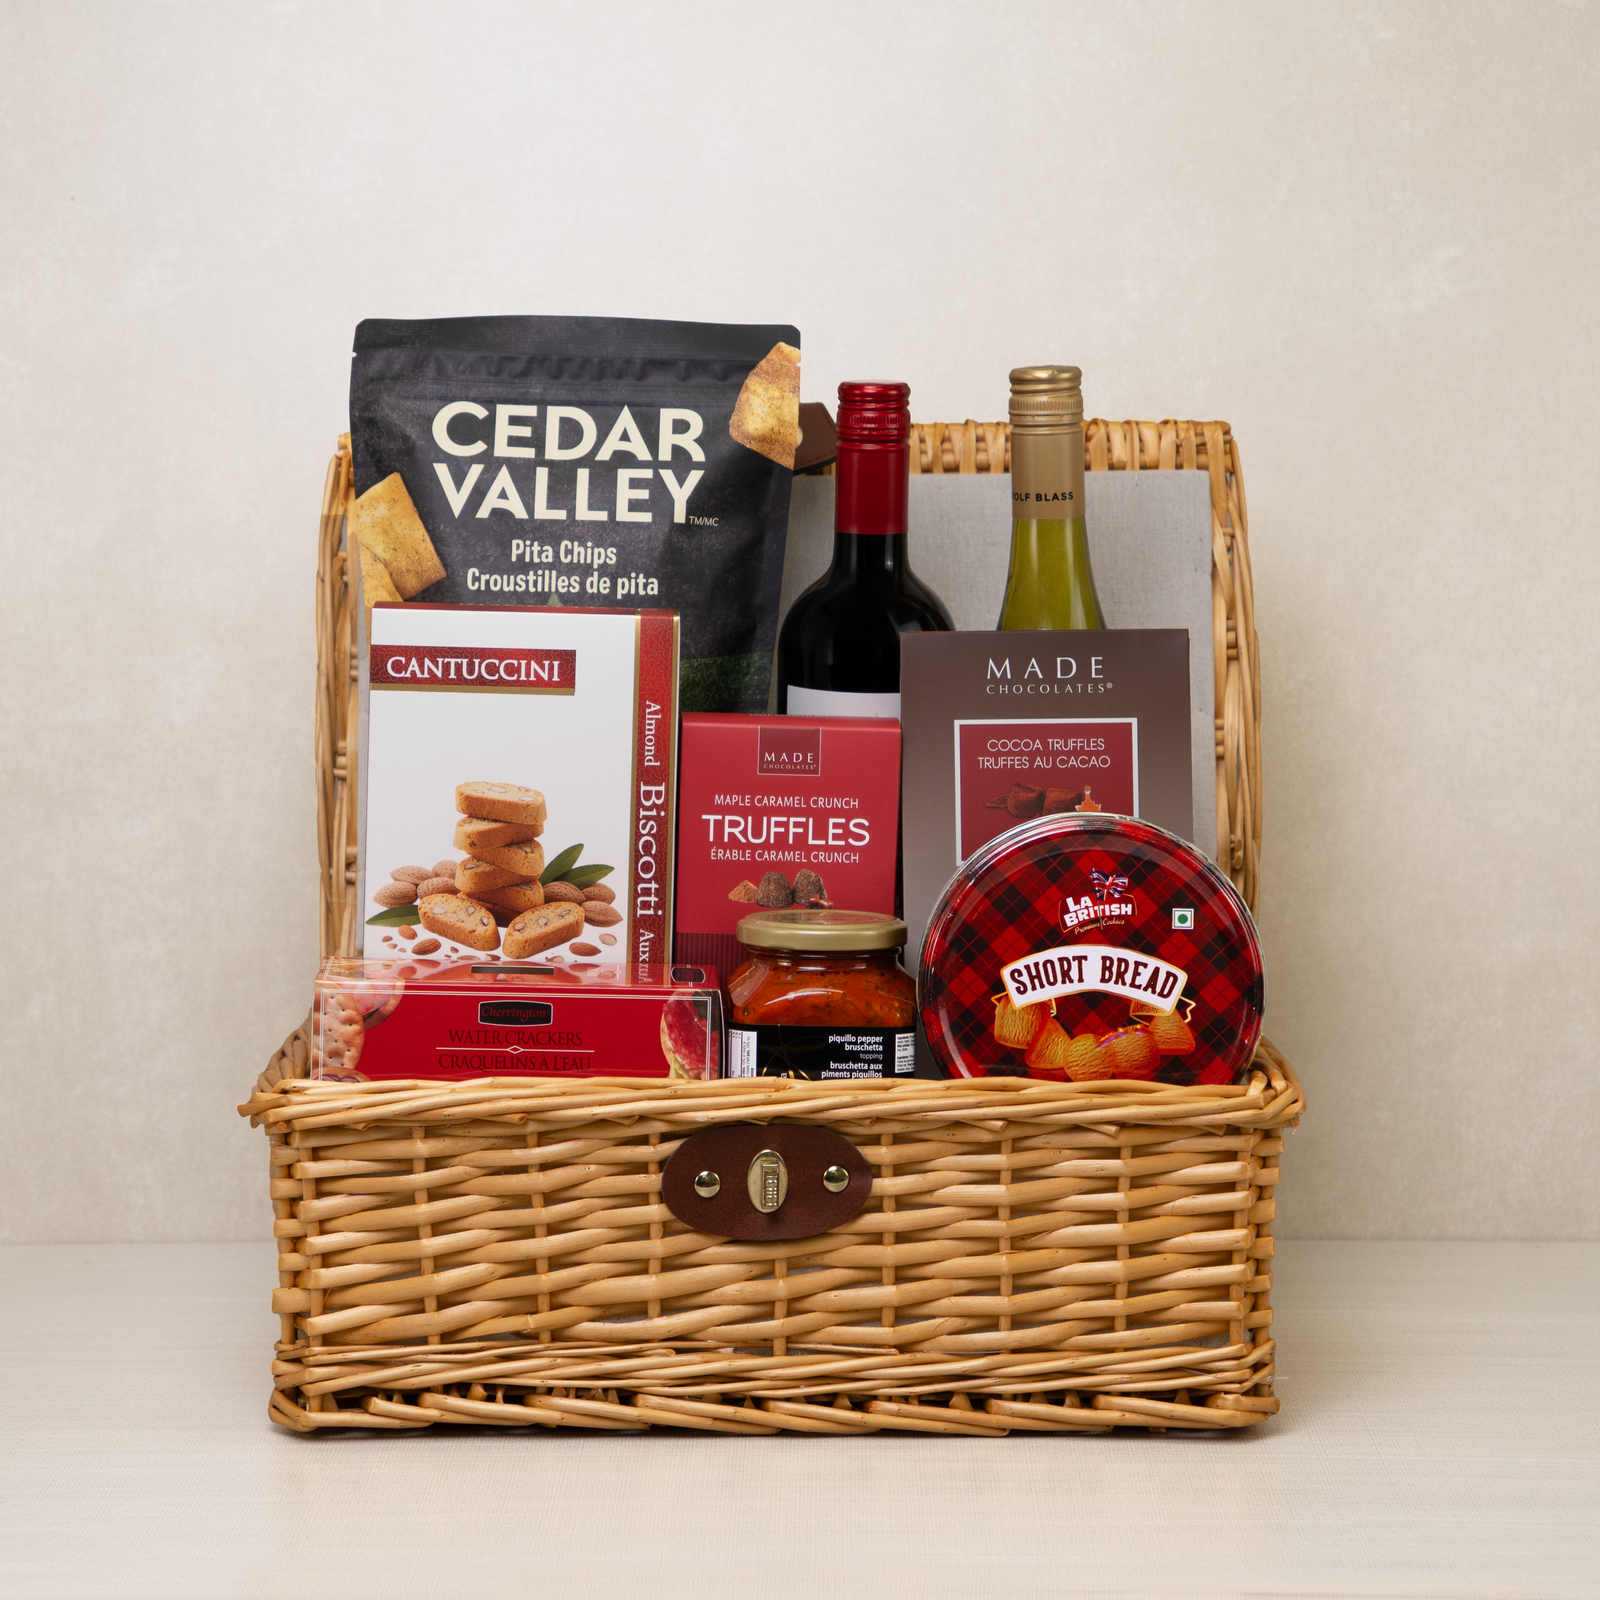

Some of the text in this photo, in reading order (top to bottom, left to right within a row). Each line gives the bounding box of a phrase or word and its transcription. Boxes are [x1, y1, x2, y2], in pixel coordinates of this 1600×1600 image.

[431, 400, 706, 461] CEDAR
[432, 462, 705, 523] VALLEY
[1035, 491, 1074, 502] BLASS
[511, 539, 617, 568] Pita Chips
[466, 568, 659, 599] Croustilles de pita
[386, 656, 561, 681] CANTUCCINI
[986, 656, 1104, 679] MADE
[987, 738, 1105, 751] COCOA TRUFFLES
[764, 752, 814, 763] MADE
[978, 755, 1111, 769] TRUFFES AU CACAO
[714, 794, 859, 809] MAPLE CARAMEL CRUNCH
[636, 700, 665, 962] Almond Biscotti Aux
[701, 814, 870, 846] TRUFFLES
[710, 846, 859, 863] ÉRABLE CARAMEL CRUNCH
[1066, 896, 1093, 913] LA
[1063, 903, 1133, 927] BRITISH
[1009, 955, 1179, 1000] SHORT BREAD
[448, 1029, 583, 1046] WATER CRACKERS
[829, 1034, 883, 1045] piquillo pepper
[845, 1043, 883, 1051] bruschetta
[438, 1054, 536, 1072] CRAQUELINS
[539, 1053, 552, 1070] À
[830, 1061, 868, 1070] bruschetta
[821, 1071, 850, 1079] piments
